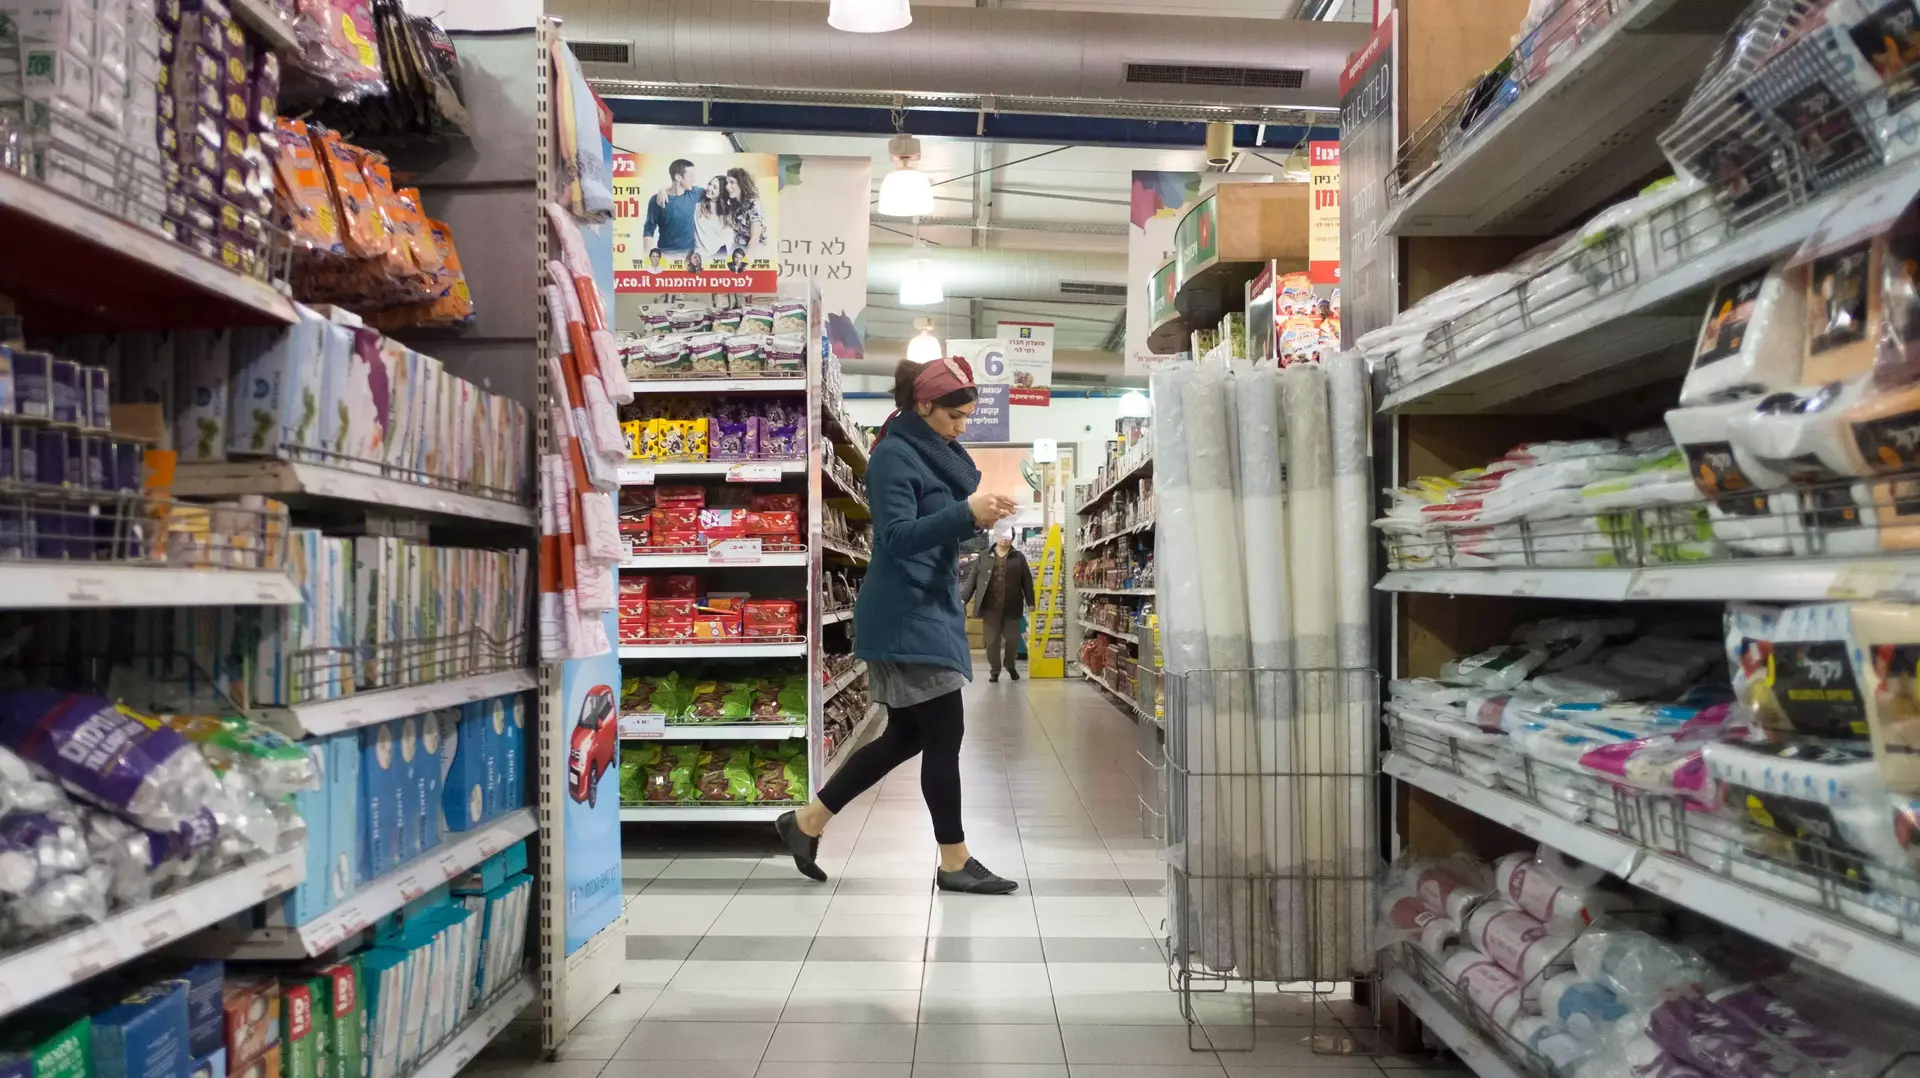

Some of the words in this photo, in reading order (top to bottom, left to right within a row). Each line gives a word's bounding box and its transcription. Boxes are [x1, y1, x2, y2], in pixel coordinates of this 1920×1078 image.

[1341, 64, 1389, 140] SELECTED
[626, 186, 640, 195] רוני
[777, 239, 812, 254] דיב
[820, 236, 845, 255] לא
[827, 260, 852, 280] לא
[655, 275, 707, 287] ולהזמנות
[709, 275, 753, 287] לפרטים
[984, 351, 1004, 376] 6
[980, 407, 1000, 416] קקאו
[973, 416, 999, 425] תחליפי
